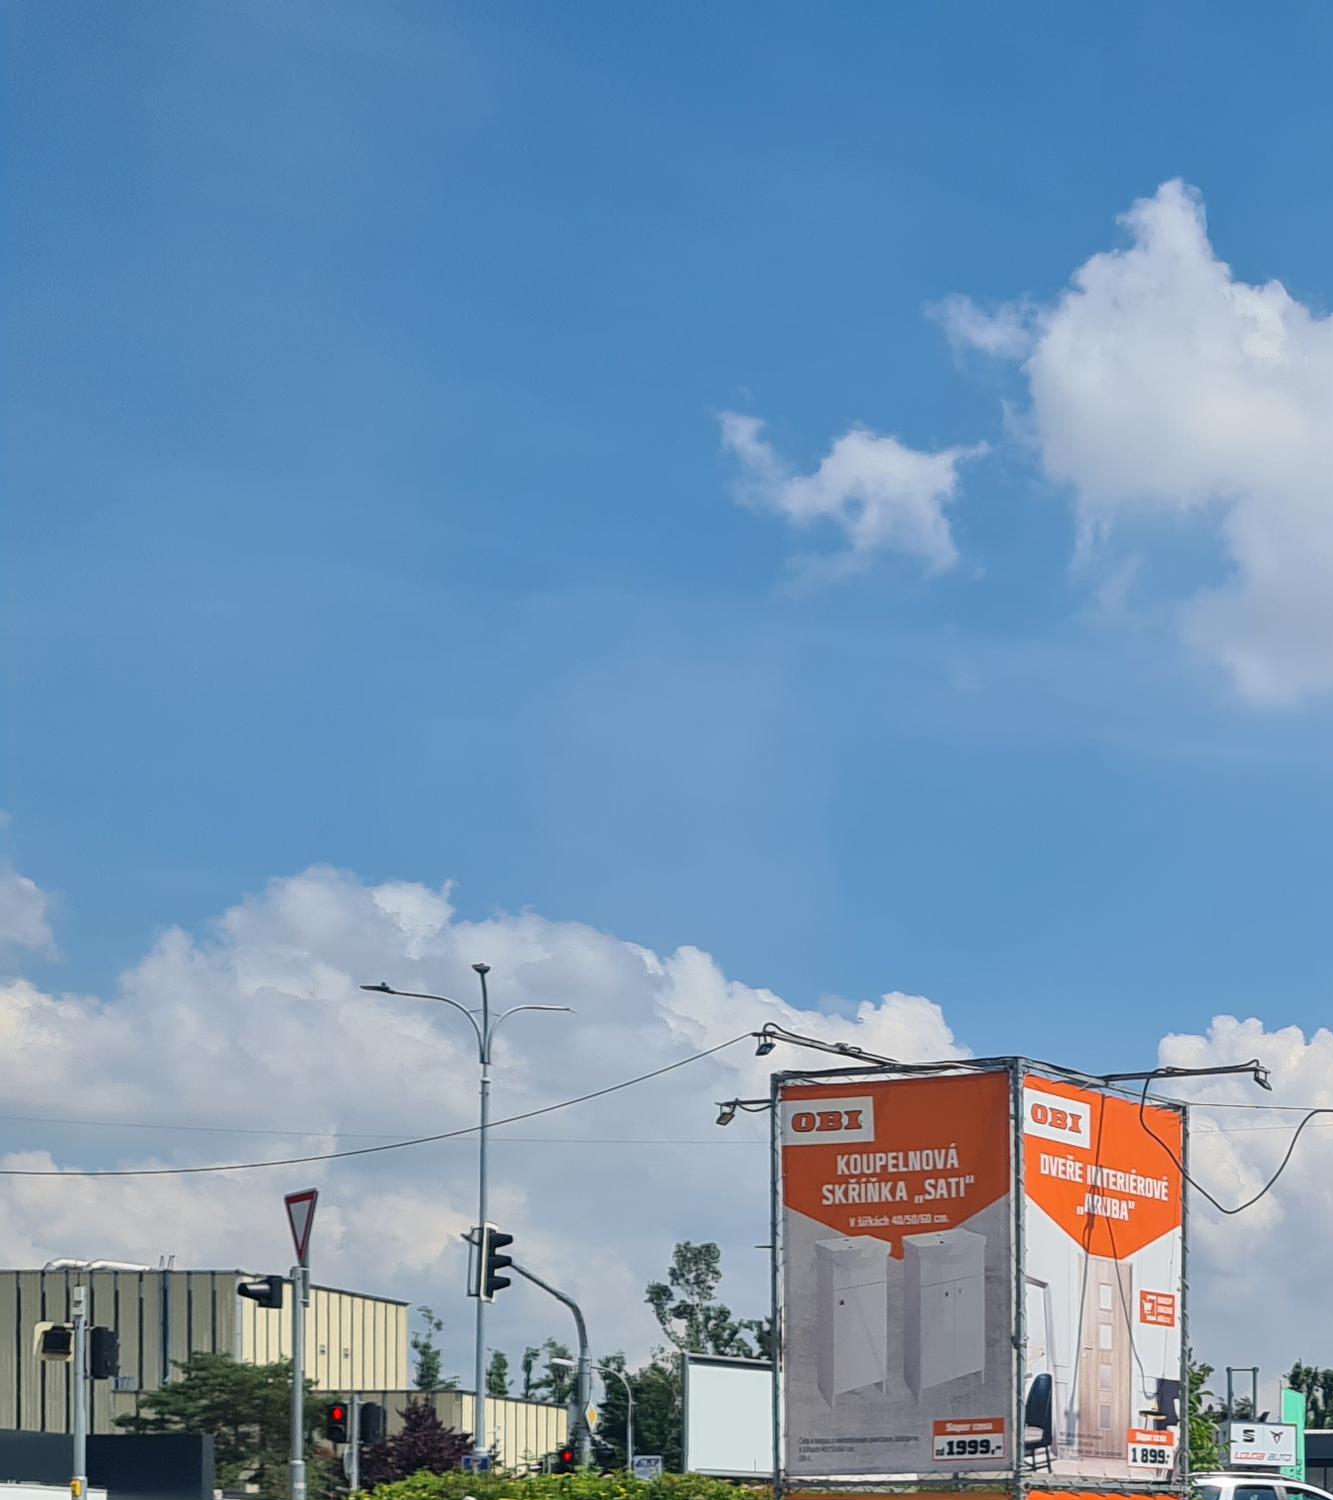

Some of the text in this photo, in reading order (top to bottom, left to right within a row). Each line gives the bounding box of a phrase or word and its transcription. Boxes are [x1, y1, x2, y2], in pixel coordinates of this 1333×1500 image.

[791, 1110, 863, 1132] OBI
[1031, 1103, 1082, 1134] OBI
[836, 1143, 959, 1175] KOUPELNOVÁ
[822, 1178, 908, 1205] SKŘÍŇKA
[1040, 1154, 1169, 1201] DVEŘE INTERIÉROVÉ
